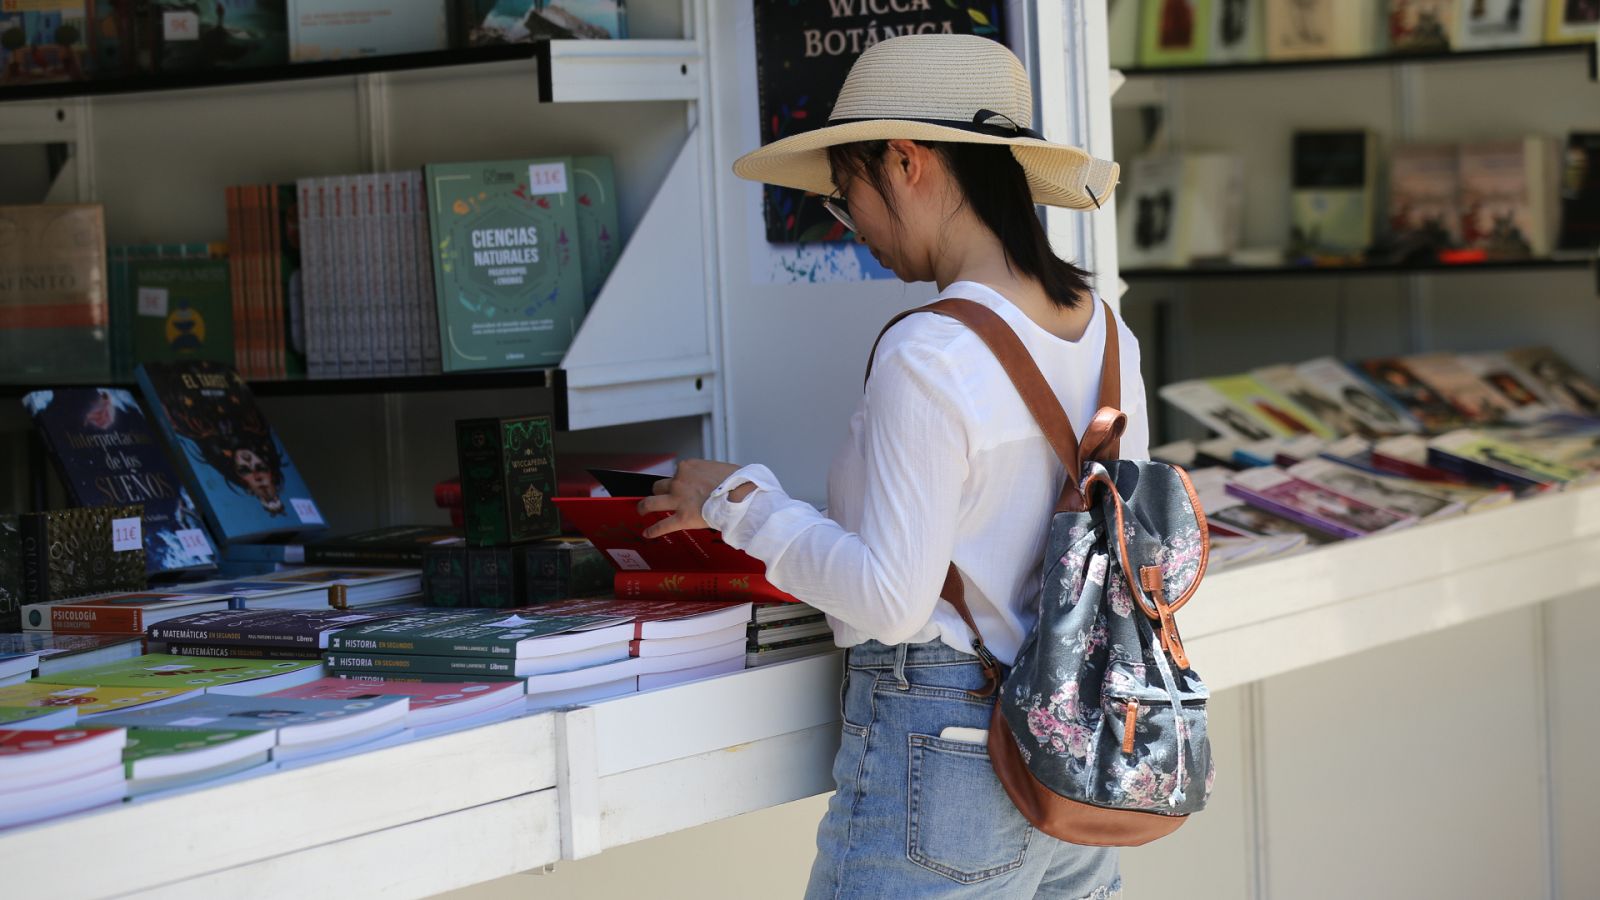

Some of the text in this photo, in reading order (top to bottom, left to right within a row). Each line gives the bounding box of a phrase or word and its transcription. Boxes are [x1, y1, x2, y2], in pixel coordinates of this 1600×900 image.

[804, 20, 954, 58] BOTÁNICA
[534, 169, 560, 185] 11€
[471, 225, 538, 248] CIENCIAS
[473, 247, 540, 267] NATURALES
[0, 274, 75, 291] FINITO
[181, 373, 199, 389] EL
[105, 450, 142, 471] de los
[511, 457, 548, 469] WICCAPEDIA
[96, 468, 175, 503] SUEÑOS
[115, 526, 137, 543] 11€
[53, 609, 97, 620] PSICOLOGÍA
[162, 628, 208, 640] MATEMÁTICAS
[181, 647, 229, 657] MATEMÁTICAS
[345, 639, 377, 649] HISTORIA
[340, 657, 373, 667] HISTORIA
